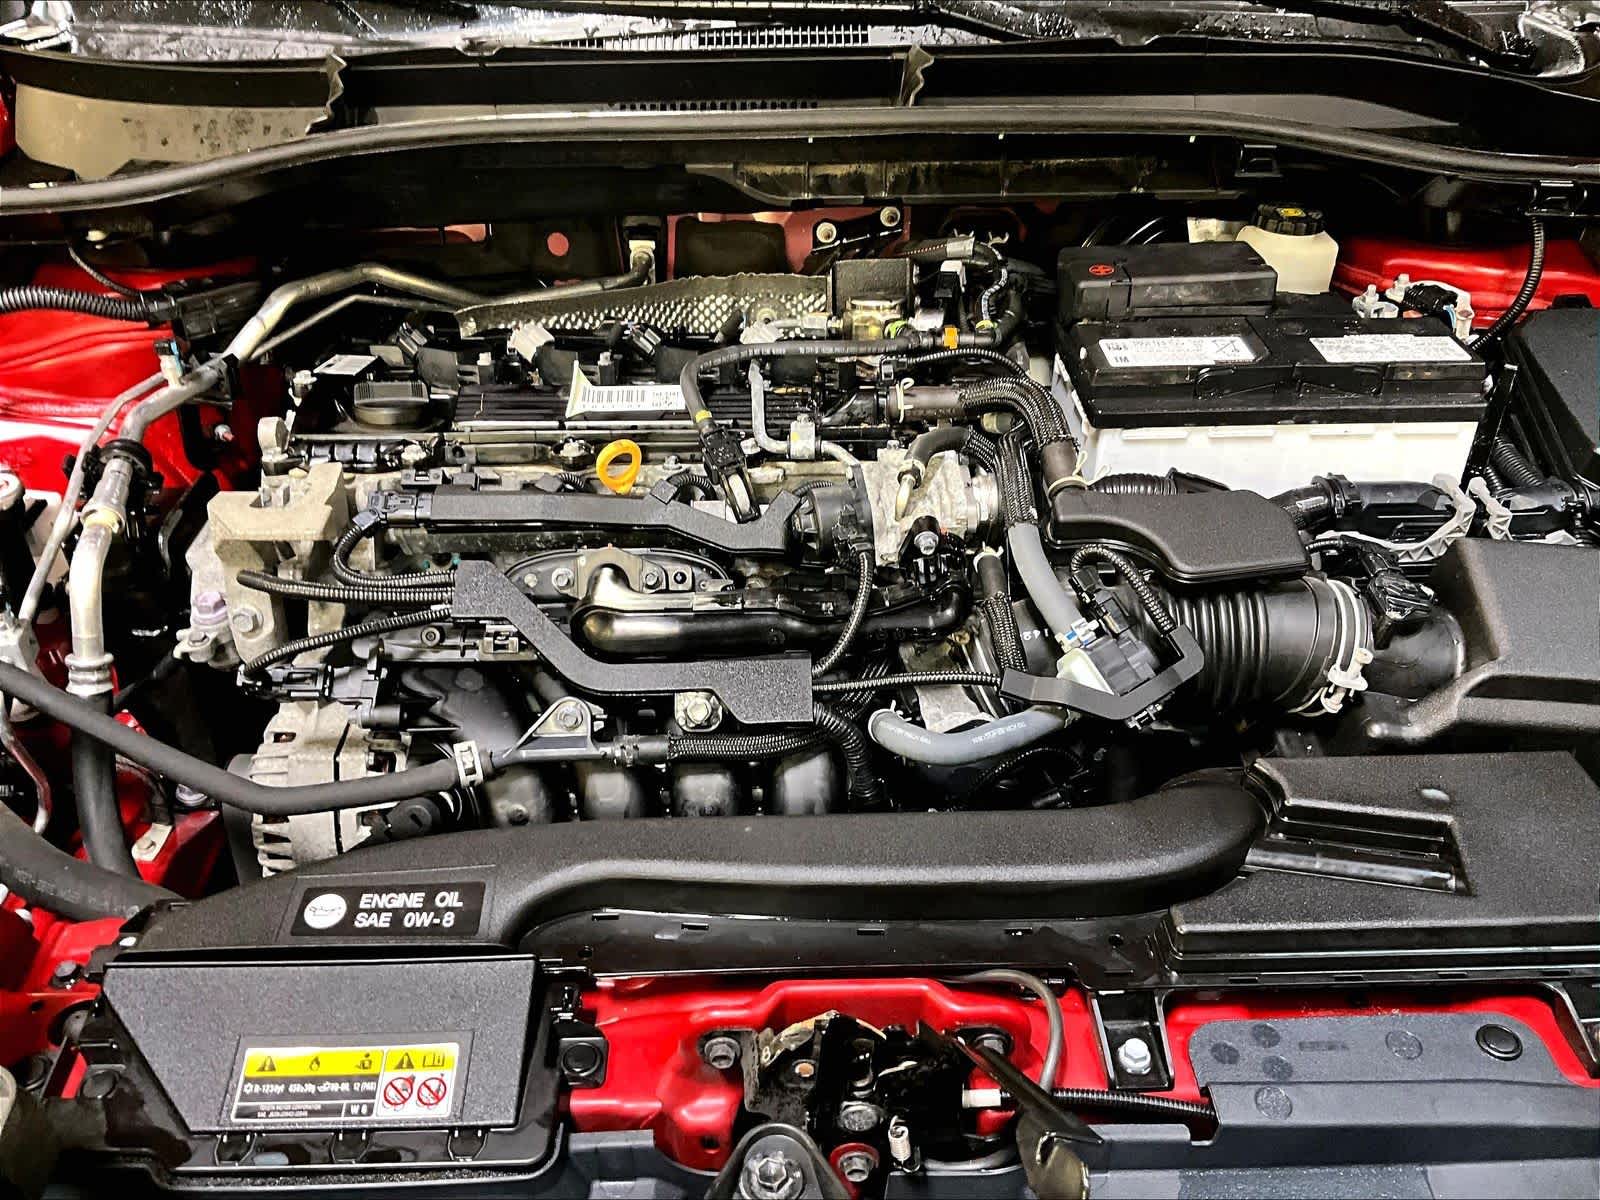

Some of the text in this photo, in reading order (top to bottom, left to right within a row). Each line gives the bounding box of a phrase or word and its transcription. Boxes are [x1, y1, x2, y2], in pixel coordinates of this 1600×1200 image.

[358, 891, 464, 909] ENGINE OIL
[354, 911, 456, 928] SAE 0W-8
